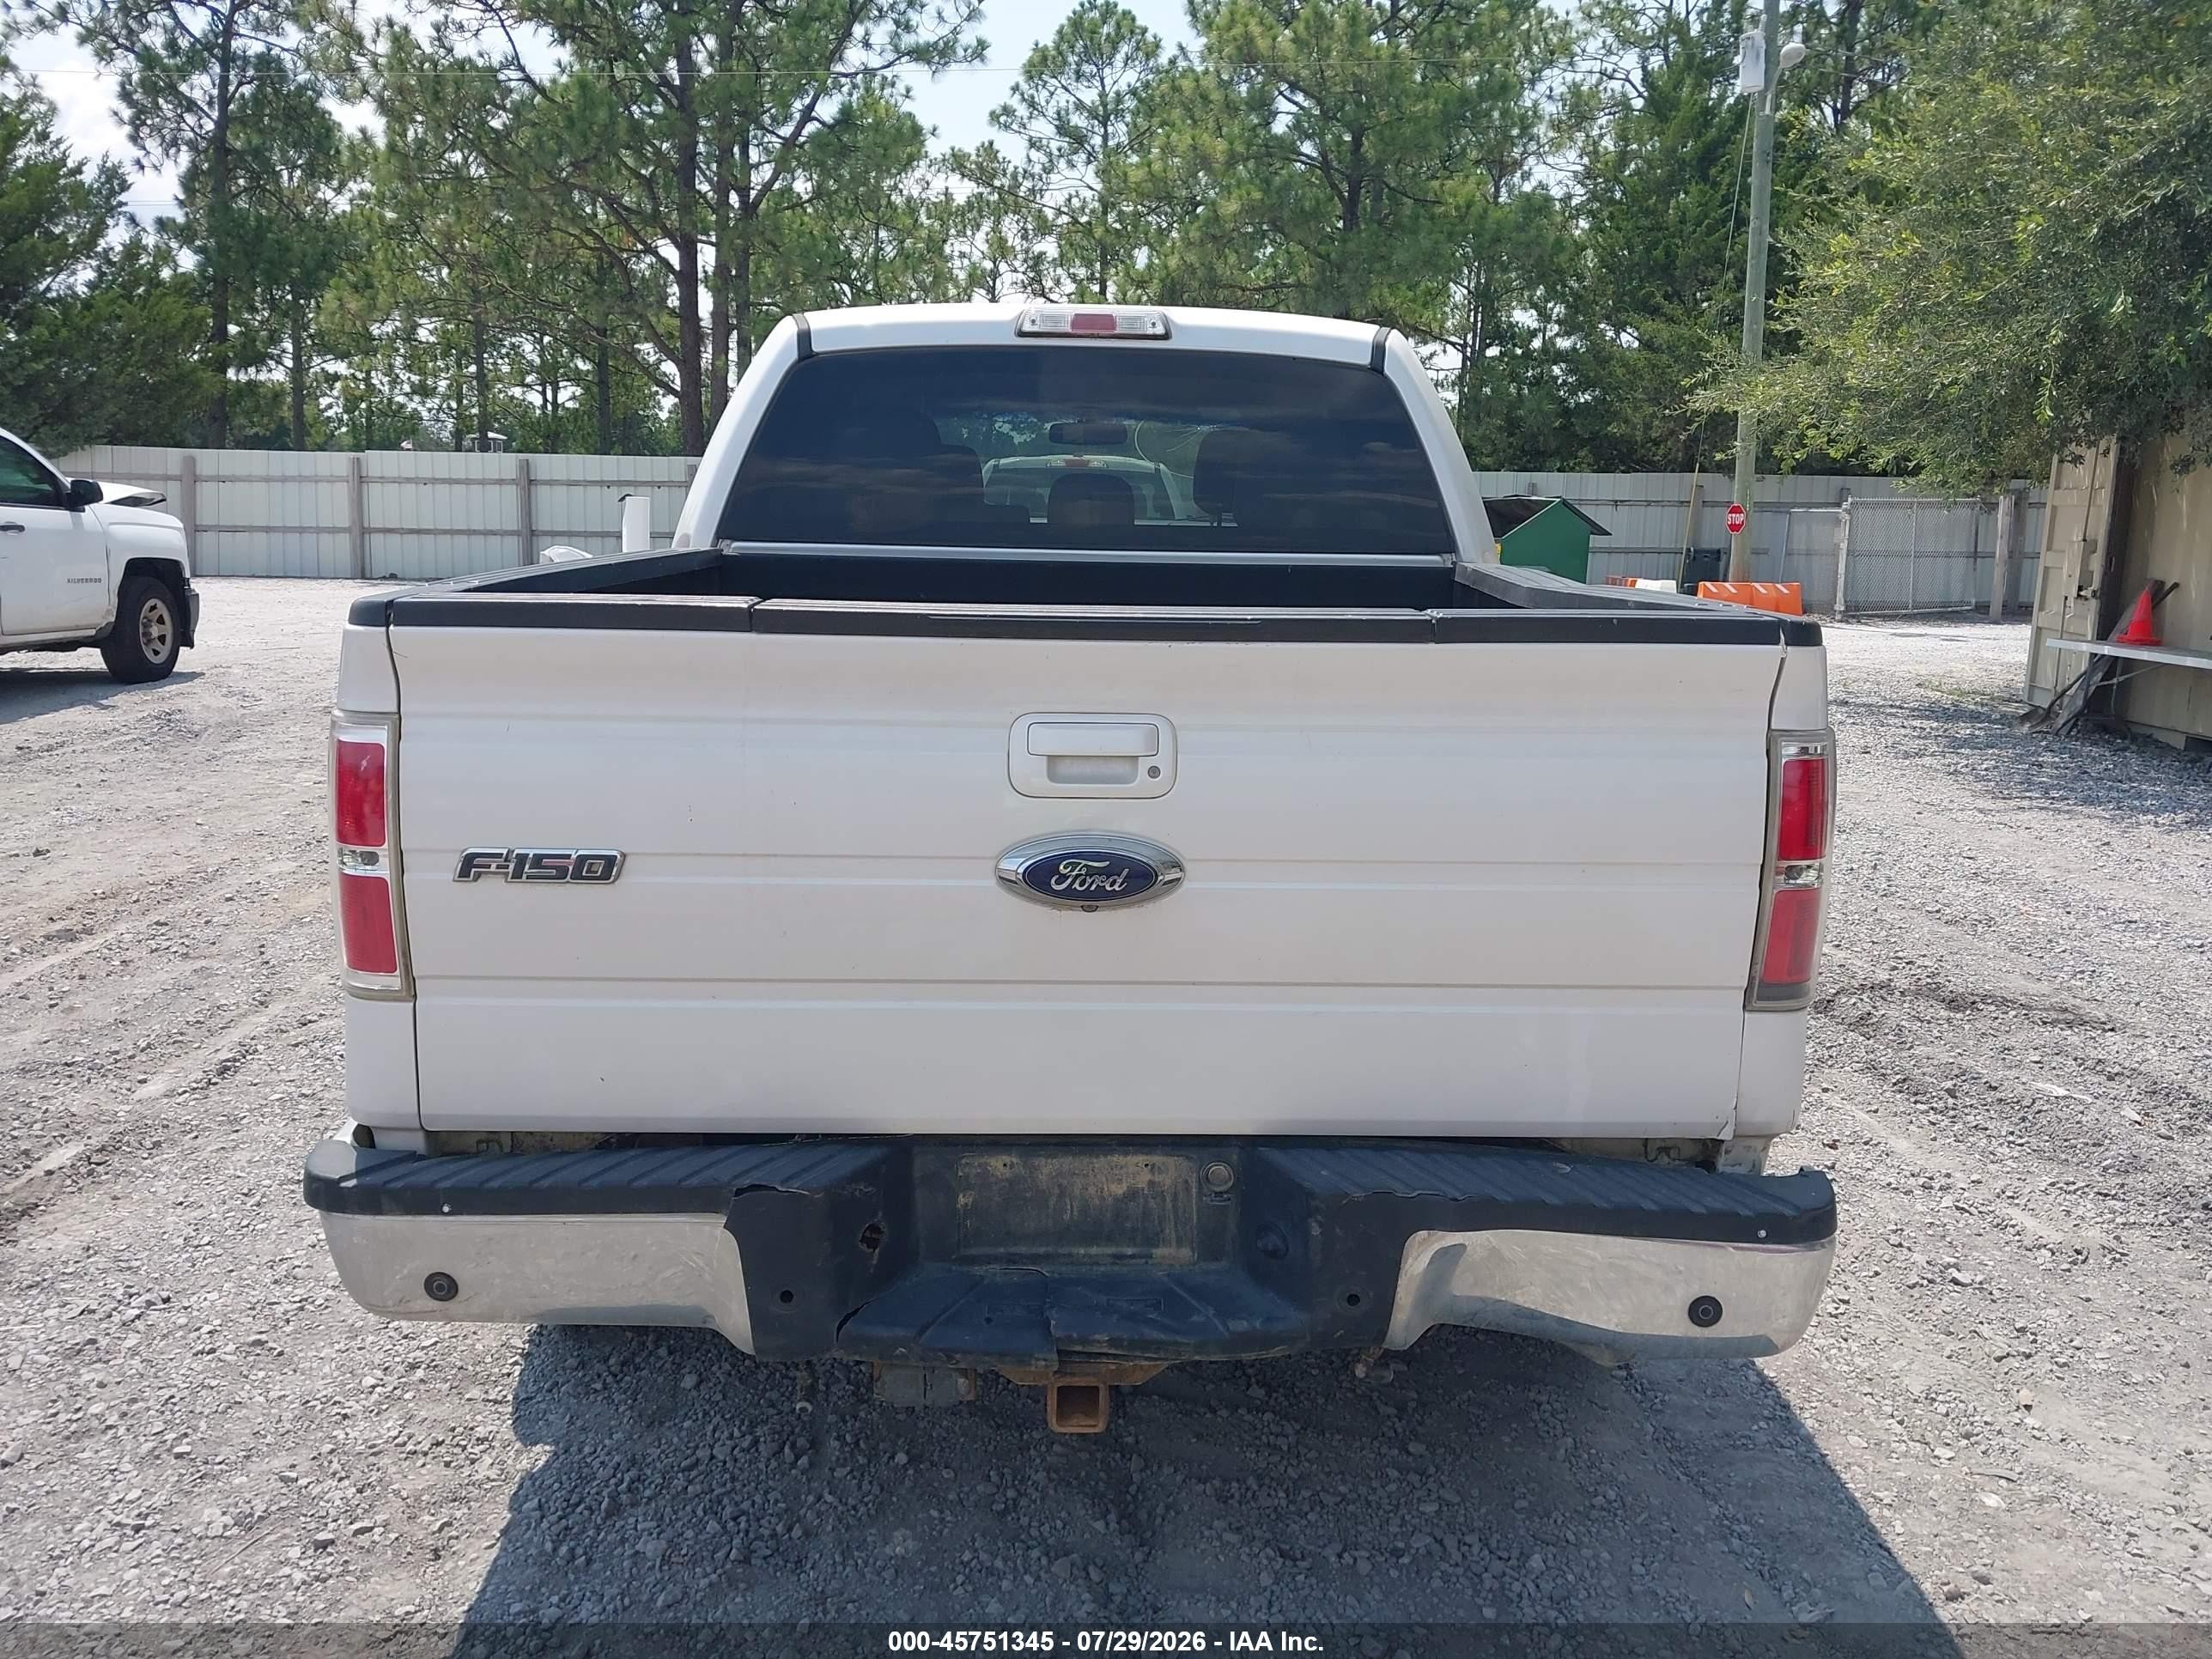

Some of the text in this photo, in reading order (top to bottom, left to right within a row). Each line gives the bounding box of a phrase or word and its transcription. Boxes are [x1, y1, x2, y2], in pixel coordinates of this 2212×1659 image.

[1727, 514, 1744, 525] STOP
[453, 847, 626, 884] F-150
[1050, 859, 1129, 891] Ford
